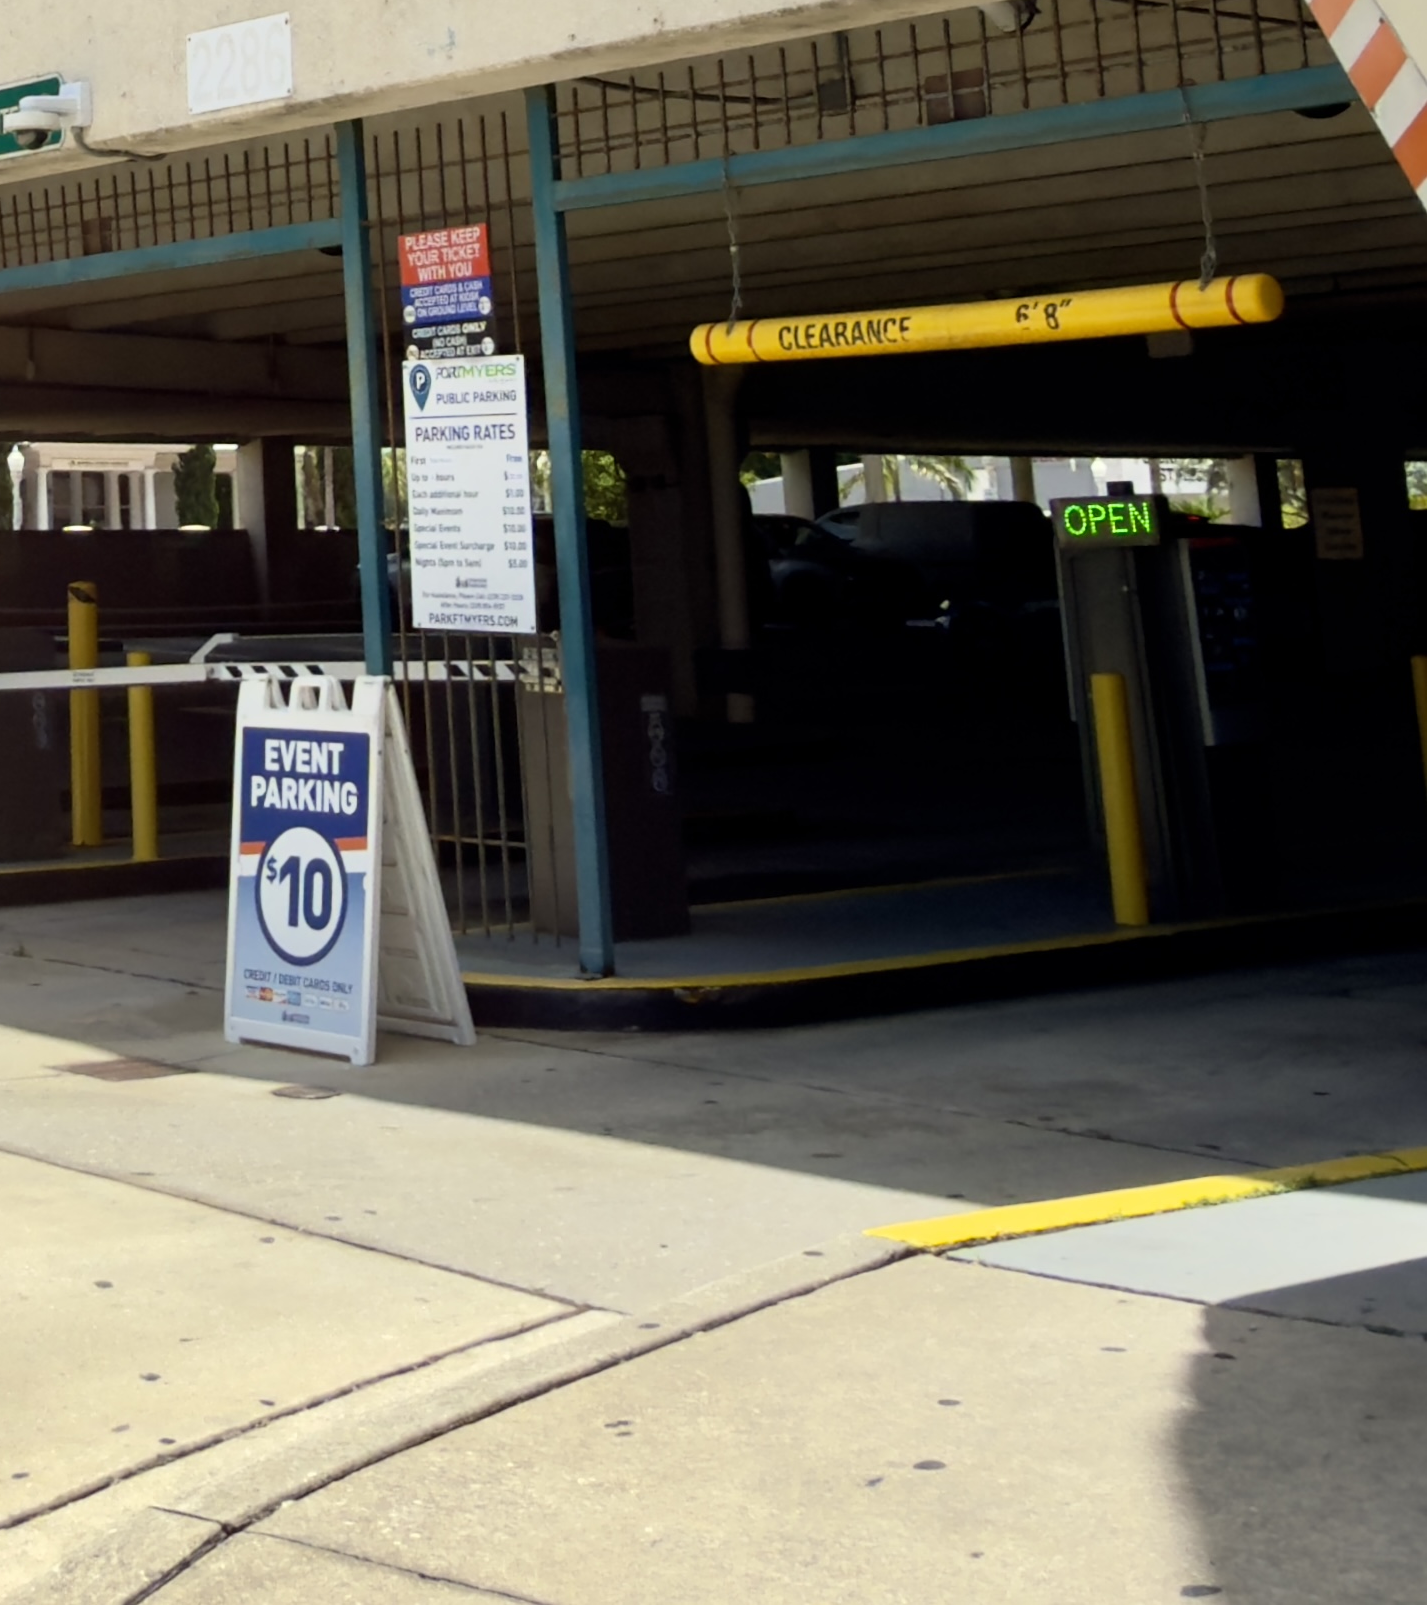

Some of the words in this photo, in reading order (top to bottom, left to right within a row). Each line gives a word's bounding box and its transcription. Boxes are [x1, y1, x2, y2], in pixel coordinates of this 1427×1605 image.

[405, 231, 448, 251] PLEASE
[450, 226, 481, 245] KEEP
[407, 249, 440, 266] YOUR
[441, 243, 480, 261] TICKET
[417, 265, 447, 282] WITH
[448, 261, 473, 278] YOU
[409, 285, 433, 298] CREDIT
[434, 282, 458, 295] CARDS
[458, 281, 464, 293] &
[464, 279, 483, 292] CASH
[414, 294, 448, 307] ACCEPTED
[449, 293, 458, 303] AT
[416, 307, 427, 318] ON
[427, 304, 457, 316] GROUND
[457, 301, 478, 313] LEVEL
[412, 326, 436, 339] CREDIT
[437, 323, 461, 336] CARDS
[461, 320, 487, 334] ONLY
[778, 316, 912, 351] CLEARANCE
[420, 346, 455, 359] ACCEPTED
[456, 345, 465, 356] AT
[465, 344, 481, 355] EXIT
[436, 392, 470, 404] PUBLIC
[473, 390, 517, 403] PARKING
[415, 425, 470, 442] PARKING
[474, 423, 516, 440] RATES
[411, 456, 426, 465] First
[1063, 501, 1152, 536] OPEN
[428, 612, 519, 628] PARKFTMYERS.COM
[264, 738, 344, 775] EVENT
[250, 775, 358, 815] PARKING
[265, 855, 333, 930] $10
[243, 968, 271, 982] CREDIT
[278, 972, 302, 987] DEBIT
[303, 976, 330, 992] CARDS
[332, 981, 353, 995] ONLY
